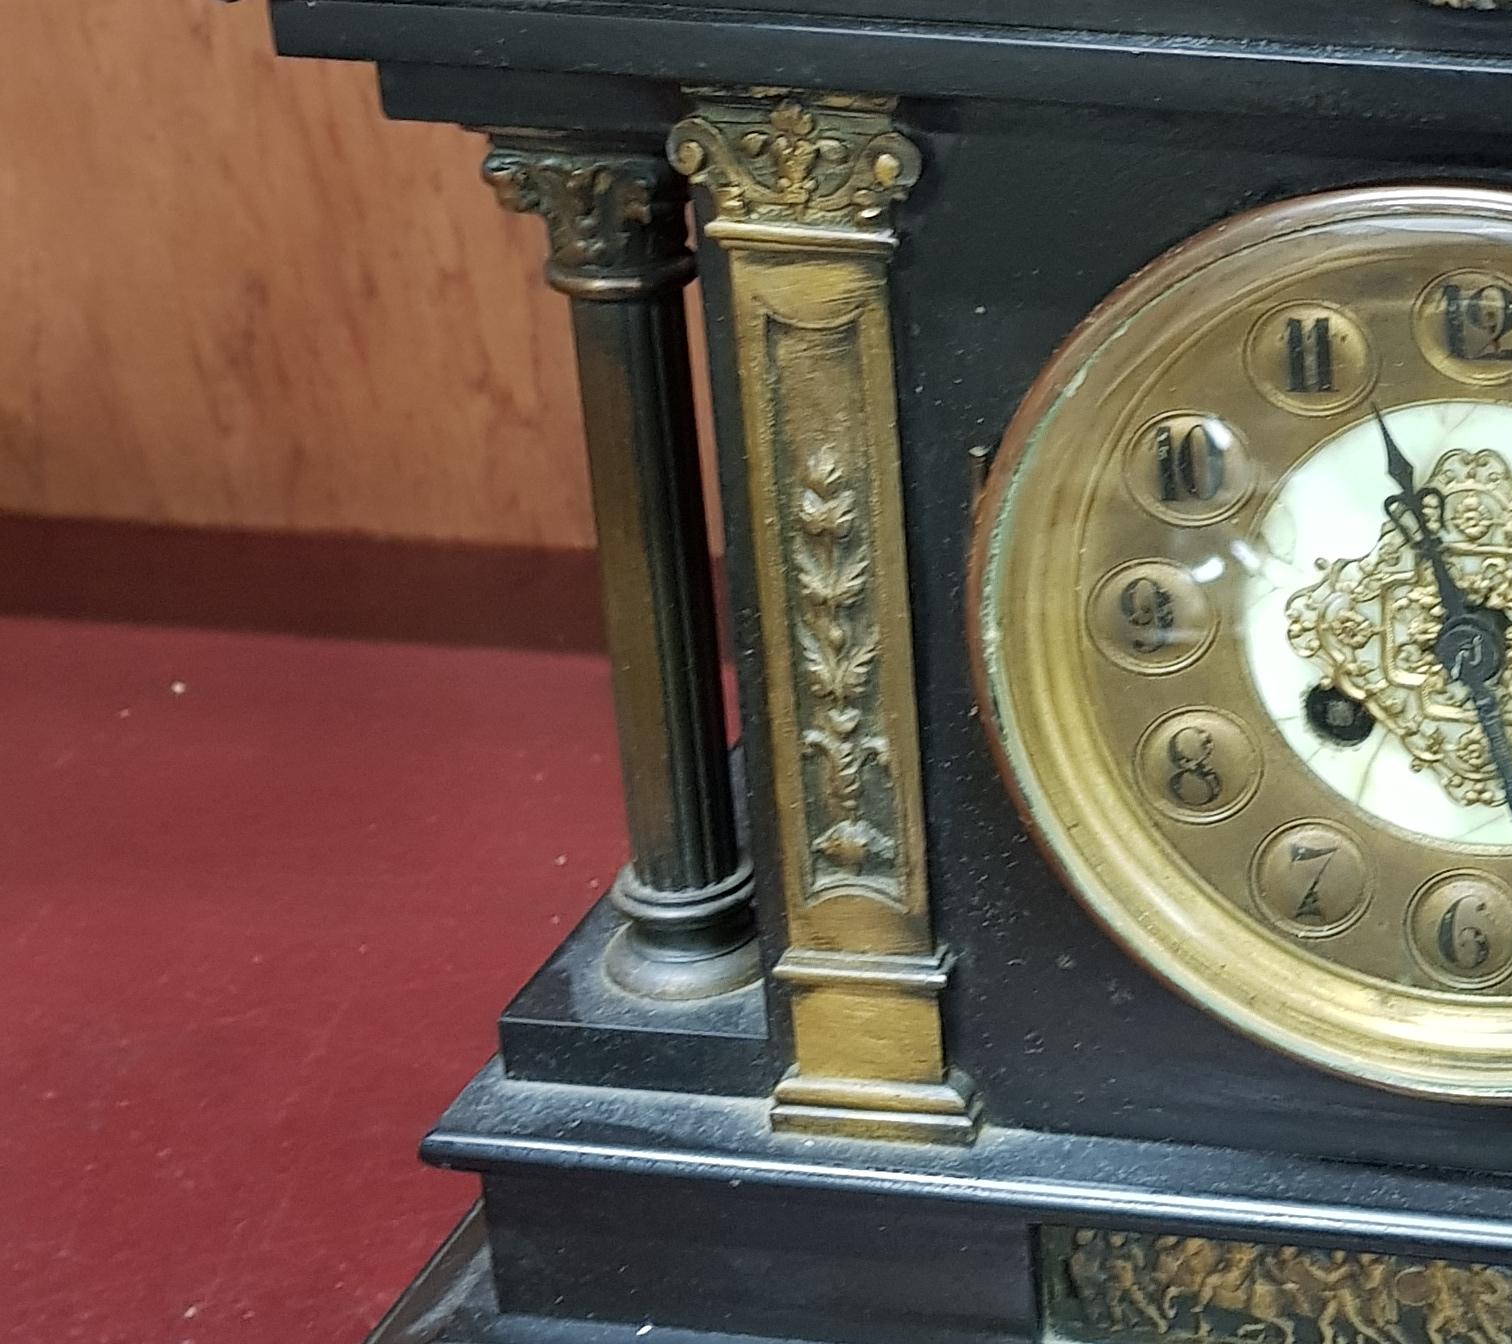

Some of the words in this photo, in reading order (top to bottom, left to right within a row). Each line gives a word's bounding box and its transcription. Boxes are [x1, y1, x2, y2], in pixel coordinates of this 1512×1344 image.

[1280, 316, 1345, 394] 11
[1155, 425, 1224, 504] 10
[1120, 577, 1176, 654] 9
[1168, 727, 1222, 804] 8
[1291, 845, 1340, 919] 7
[1437, 893, 1490, 968] 6
